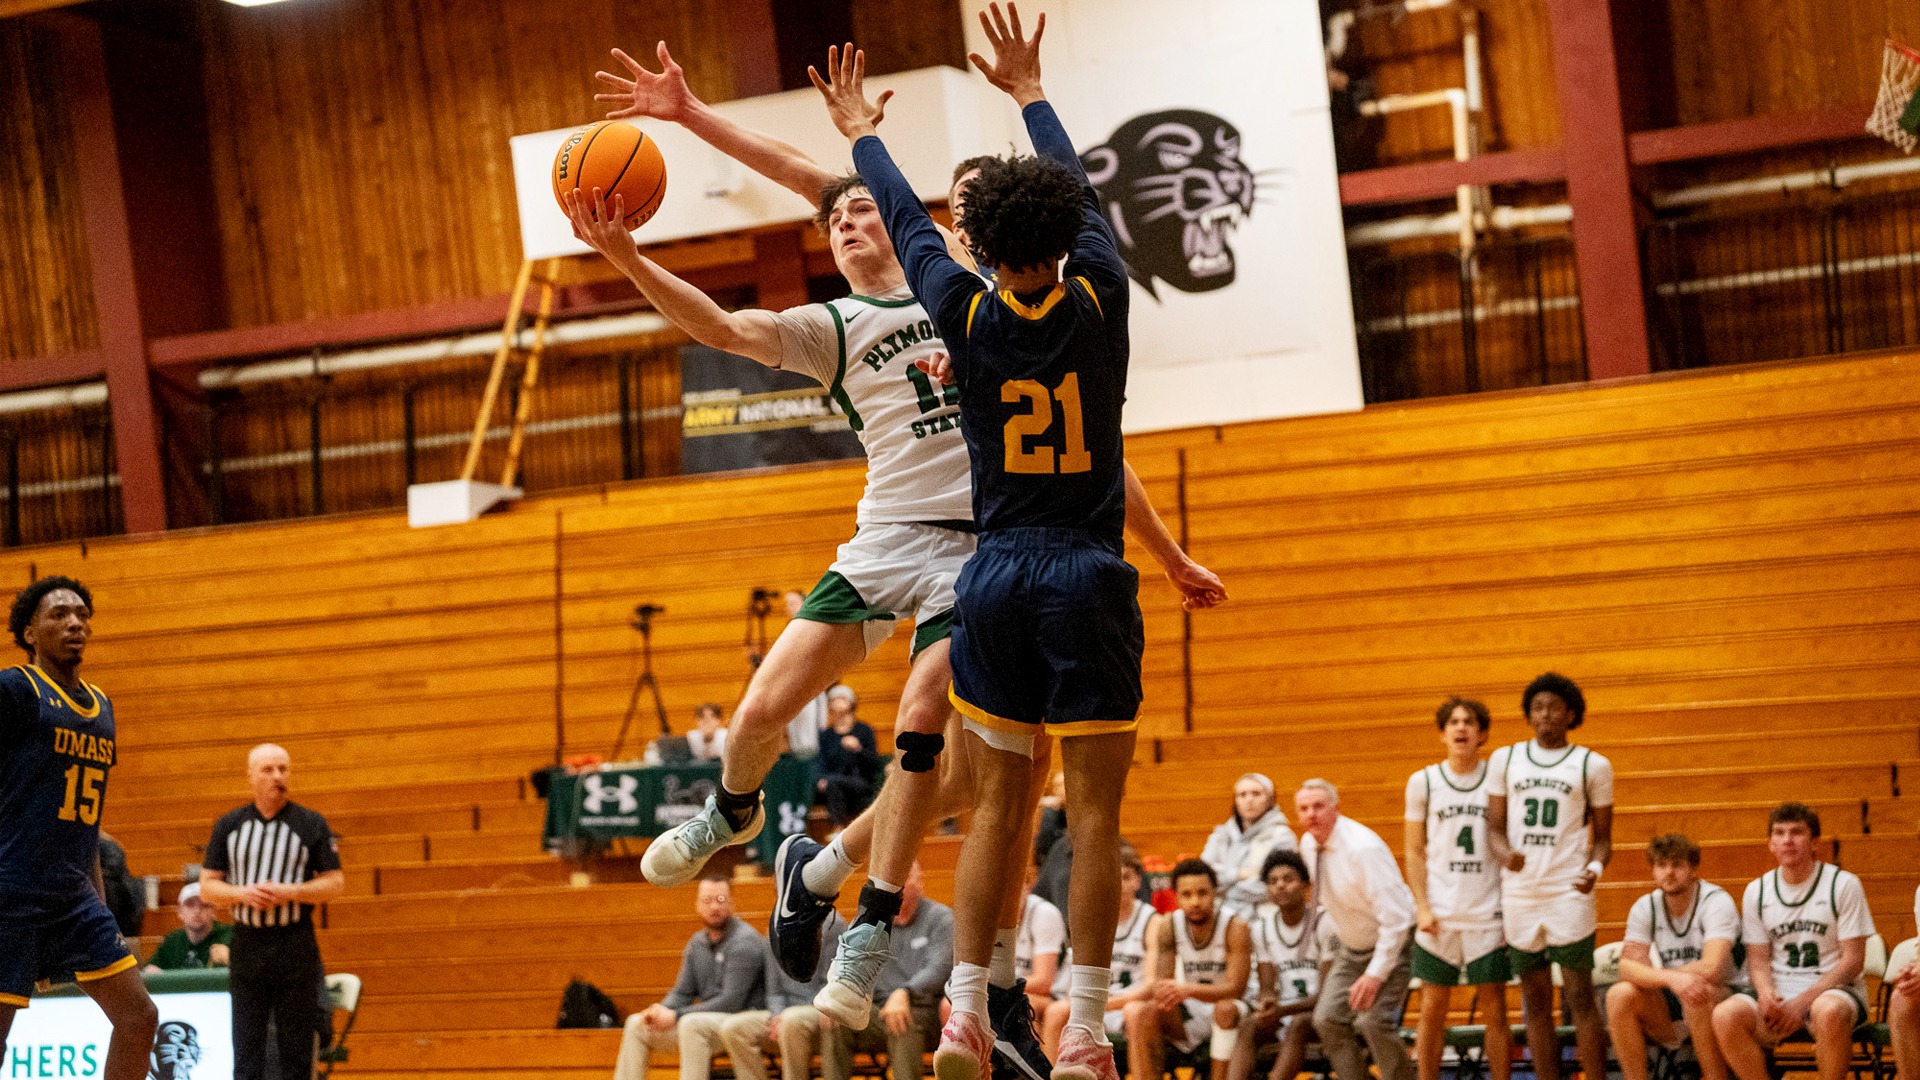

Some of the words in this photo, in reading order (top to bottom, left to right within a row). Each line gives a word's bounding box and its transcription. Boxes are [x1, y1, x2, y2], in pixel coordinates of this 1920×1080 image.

[1001, 372, 1091, 473] 21
[54, 727, 114, 765] UMASS
[58, 764, 105, 826] 15
[1524, 798, 1559, 827] 30
[1457, 825, 1475, 855] 4
[6, 1044, 97, 1079] HERS
